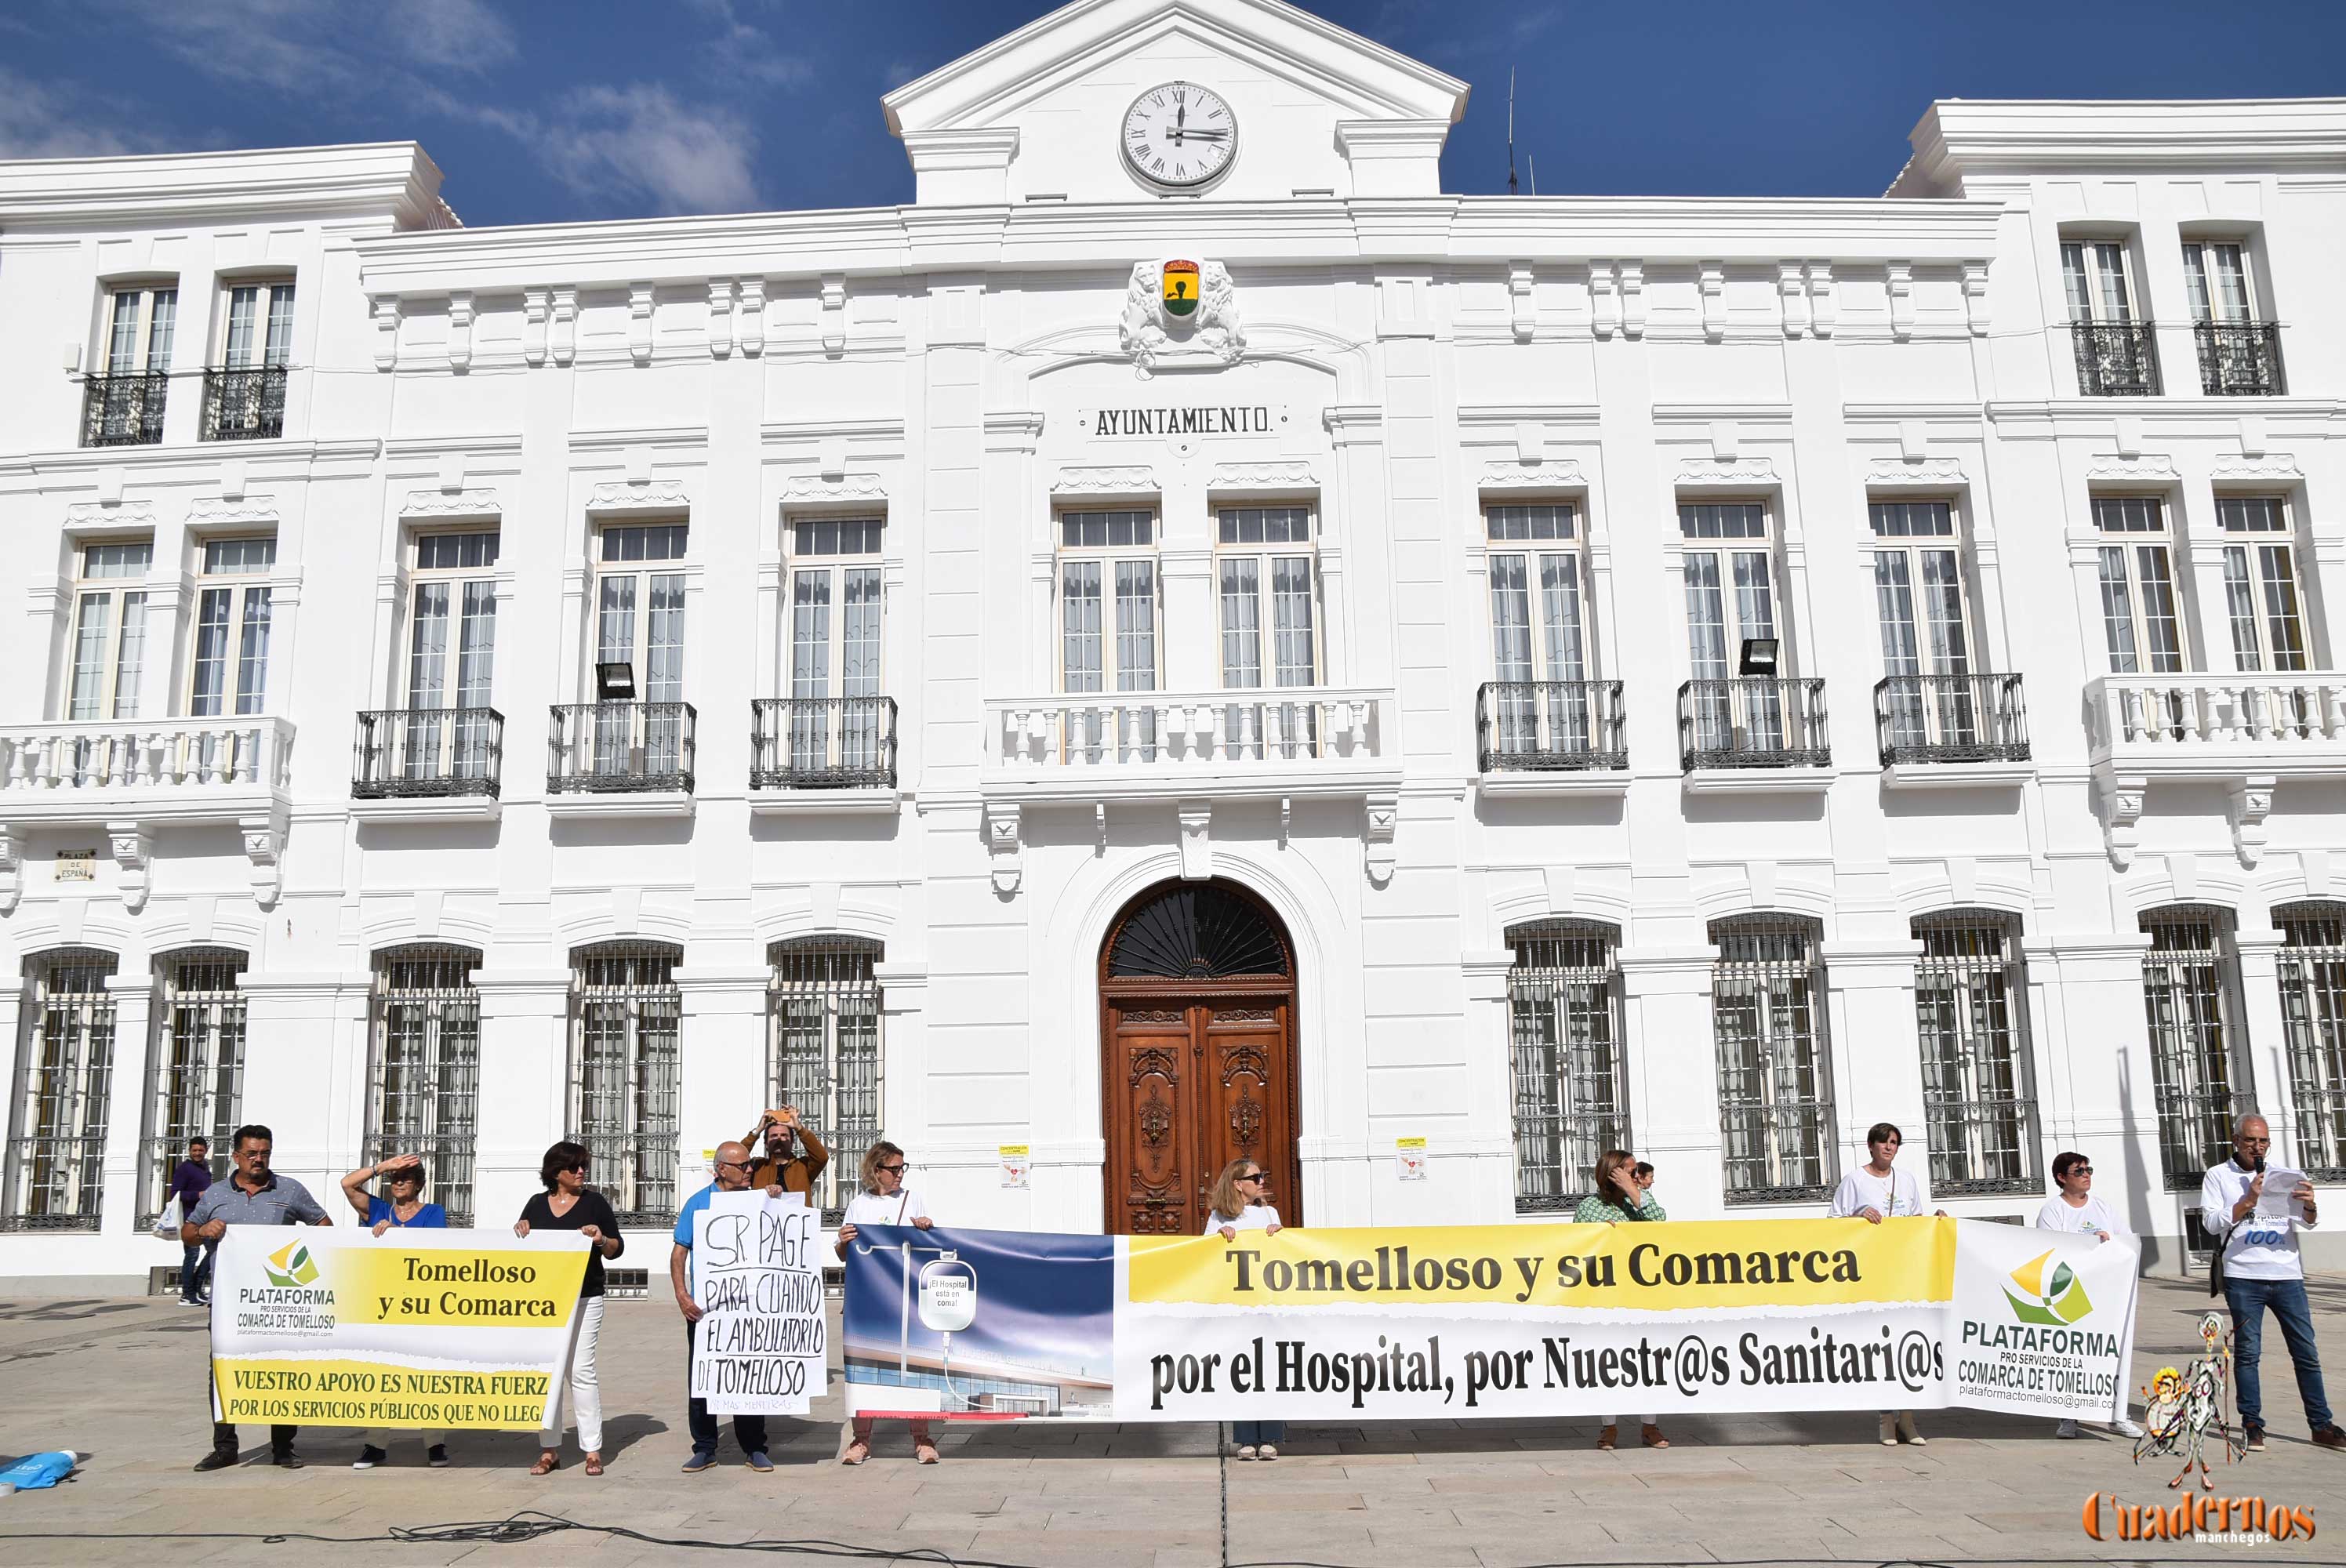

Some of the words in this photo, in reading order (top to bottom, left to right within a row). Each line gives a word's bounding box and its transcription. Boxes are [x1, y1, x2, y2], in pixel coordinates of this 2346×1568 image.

[1095, 407, 1273, 435] AYUNTAMIENTO.
[62, 868, 88, 877] ESPAÑA
[706, 1214, 750, 1267] SR.
[759, 1210, 811, 1269] PAGE
[404, 1258, 536, 1283] Tomelloso
[940, 1279, 967, 1290] Hospital
[1226, 1246, 1502, 1292] Tomelloso
[1513, 1257, 1544, 1301] y
[1557, 1254, 1616, 1287] su
[1628, 1243, 1861, 1286] Comarca
[240, 1288, 335, 1305] PLATAFORMA
[377, 1297, 394, 1320] y
[400, 1296, 430, 1315] su
[440, 1291, 557, 1317] Comarca
[705, 1275, 750, 1313] PARA
[756, 1273, 822, 1315] CUANDO
[237, 1329, 333, 1338] plataformactomelloso@gmail.com
[238, 1313, 274, 1327] COMARCA
[276, 1314, 286, 1328] DE
[289, 1314, 336, 1329] TOMELLOSO
[706, 1319, 722, 1352] EL
[726, 1317, 824, 1354] AMBULATORIO
[1963, 1320, 2119, 1358] PLATAFORMA
[1150, 1352, 1222, 1410] por
[1230, 1336, 1266, 1394] el
[1275, 1334, 1454, 1409] Hospital,
[1464, 1348, 1534, 1406] por
[1542, 1334, 1730, 1396] Nuestr@s
[1740, 1325, 1944, 1392] Sanitari@s
[2000, 1352, 2017, 1363] PRO
[2019, 1354, 2061, 1367] SERVICIOS
[2062, 1357, 2072, 1368] DE
[2073, 1358, 2083, 1369] LA
[234, 1370, 312, 1391] VUESTRO
[315, 1372, 375, 1392] APOYO
[380, 1374, 401, 1392] ES
[406, 1374, 486, 1395] NUESTRA
[715, 1359, 805, 1396] TOMELLOSO
[1958, 1359, 2025, 1389] COMARCA
[2028, 1367, 2043, 1391] DE
[229, 1399, 259, 1416] POR
[263, 1399, 289, 1417] LOS
[292, 1400, 365, 1418] SERVICIOS
[369, 1398, 439, 1420] PÚBLICOS
[444, 1403, 474, 1424] QUE
[478, 1405, 499, 1421] NO
